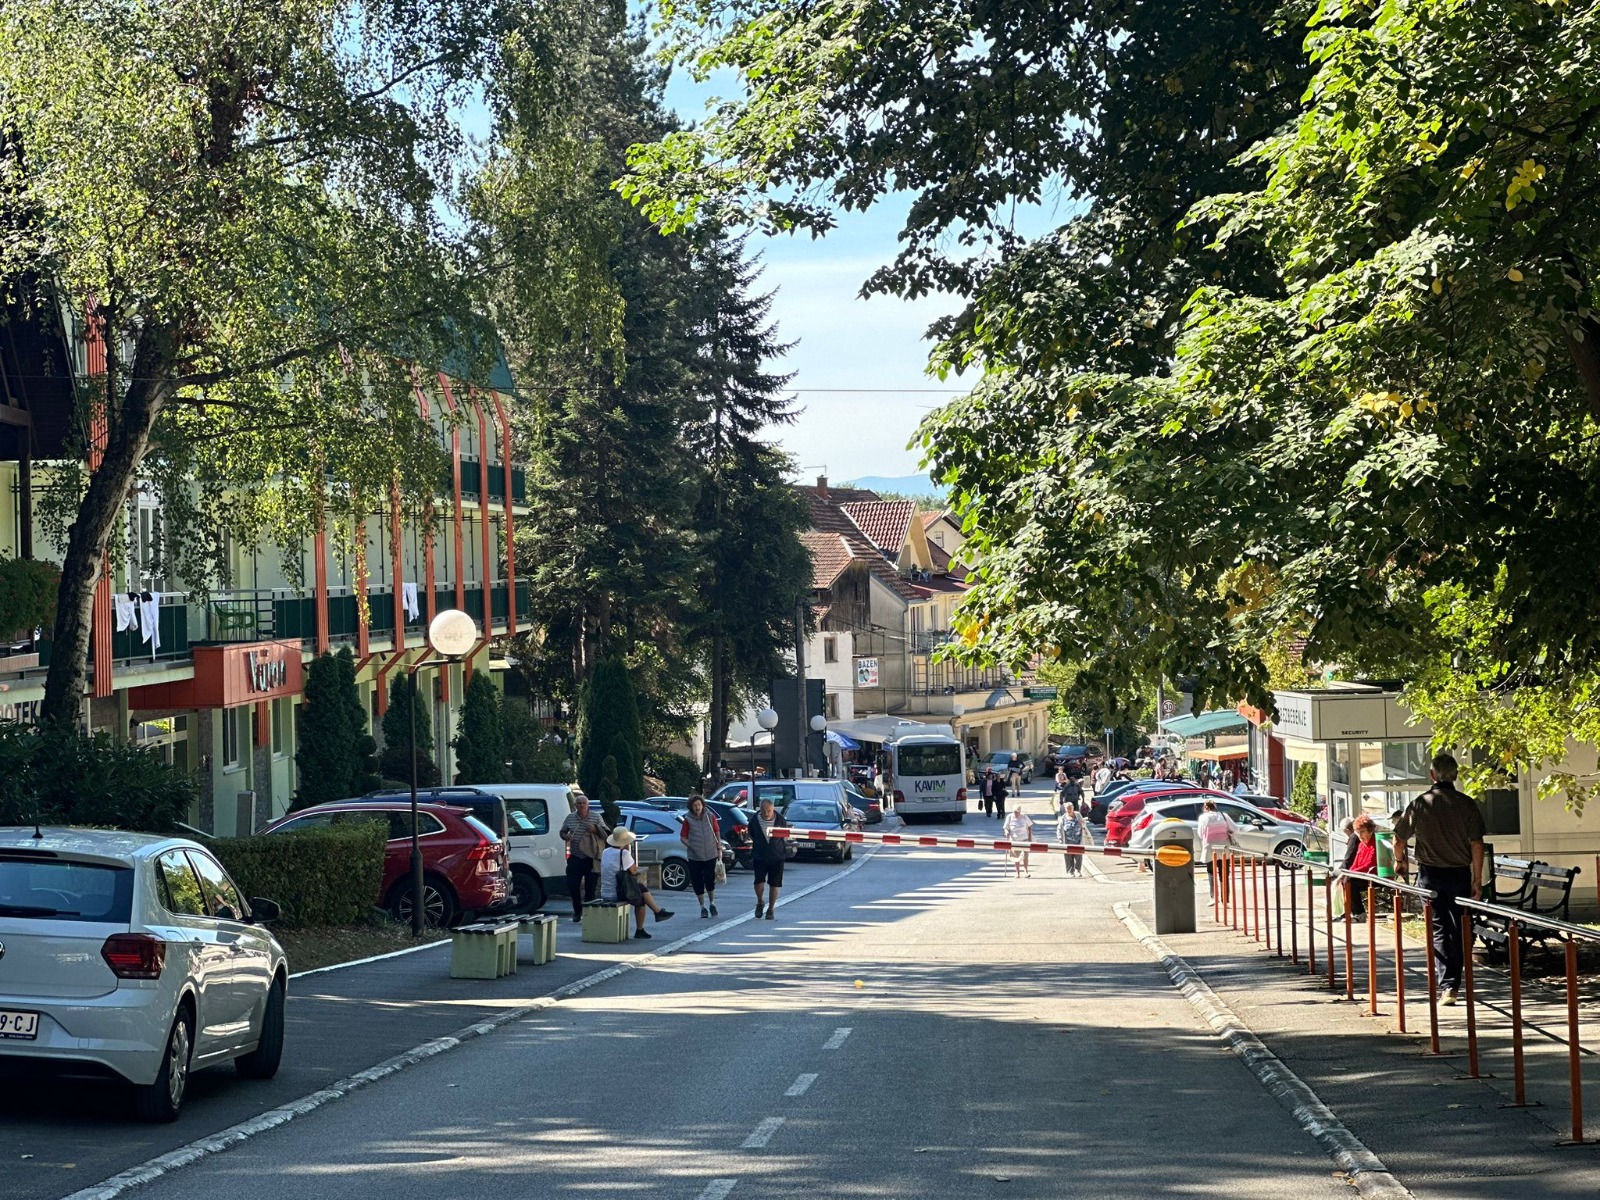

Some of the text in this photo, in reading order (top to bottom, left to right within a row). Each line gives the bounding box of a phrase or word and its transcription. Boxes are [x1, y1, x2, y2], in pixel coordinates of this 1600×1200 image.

[858, 660, 878, 668] BAZEN
[1165, 703, 1173, 711] 30
[914, 780, 946, 793] KAVIM
